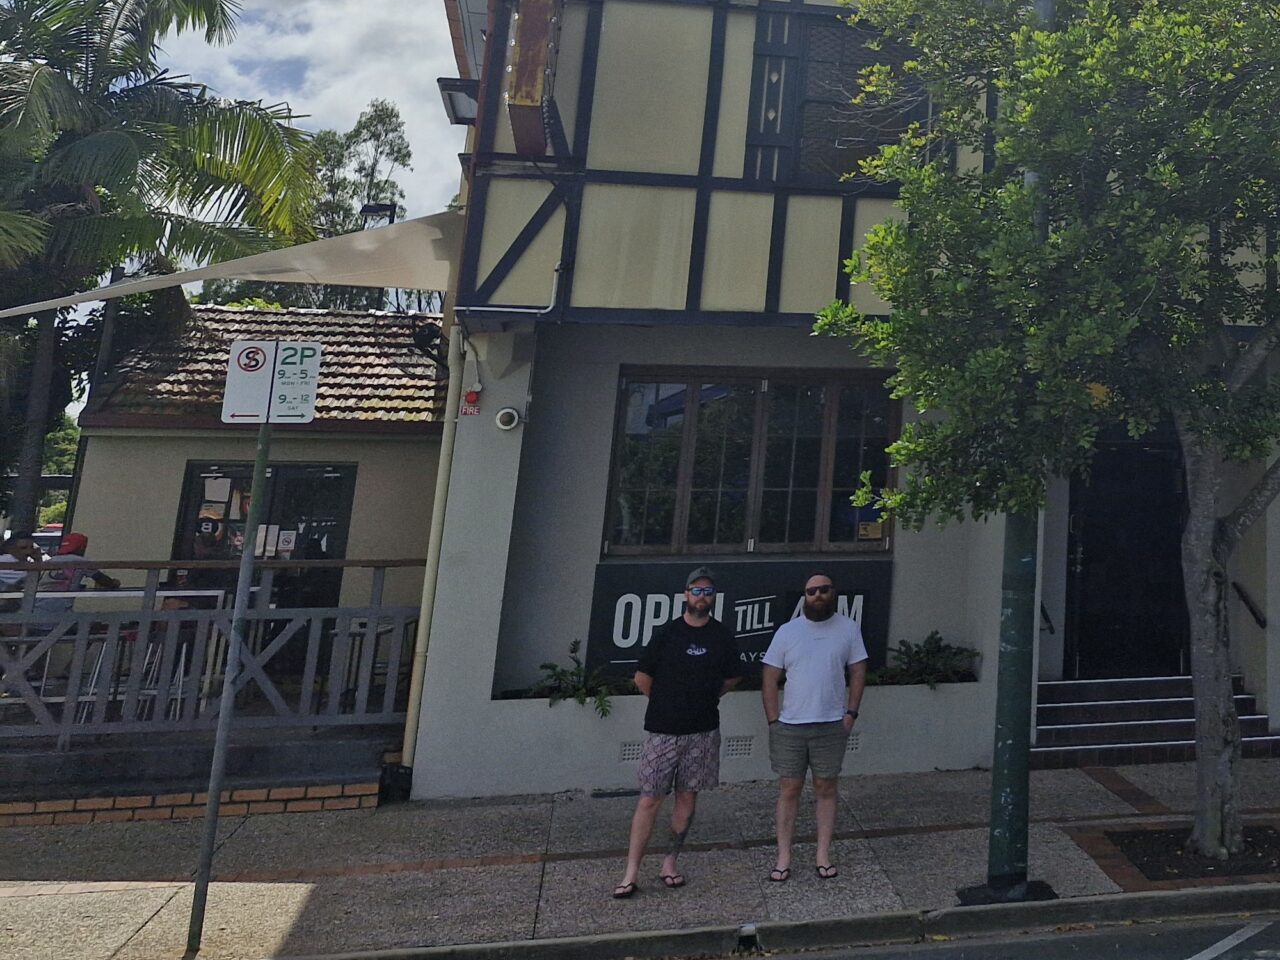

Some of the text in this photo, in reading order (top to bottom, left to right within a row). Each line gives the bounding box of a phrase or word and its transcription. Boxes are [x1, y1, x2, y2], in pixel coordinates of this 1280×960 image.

[280, 346, 317, 366] 2P
[461, 406, 480, 415] FIRE
[734, 601, 774, 632] TILL
[739, 650, 766, 663] AYS
